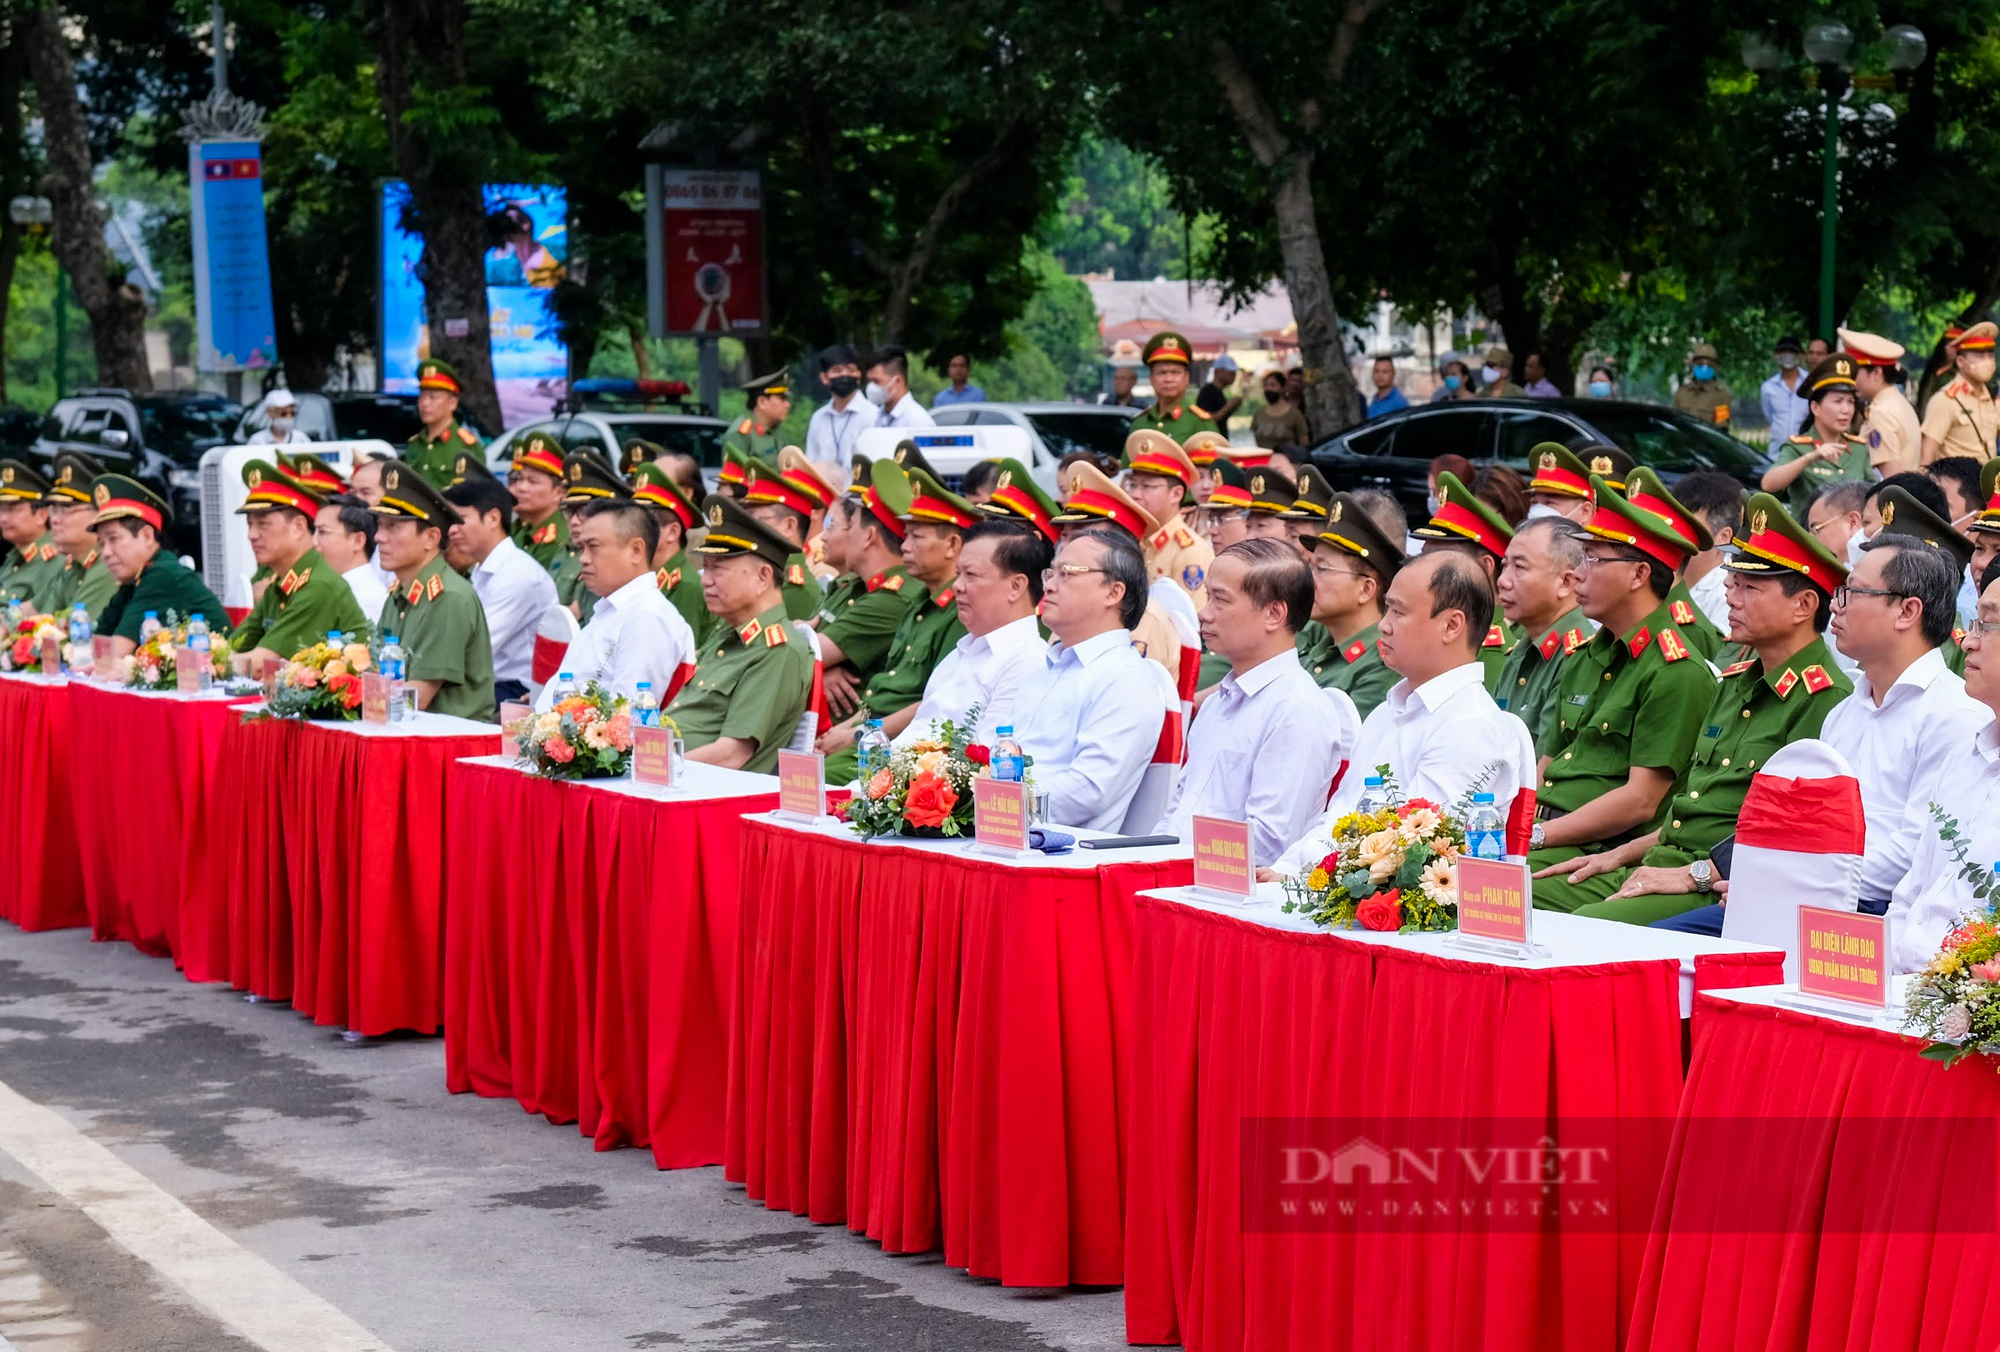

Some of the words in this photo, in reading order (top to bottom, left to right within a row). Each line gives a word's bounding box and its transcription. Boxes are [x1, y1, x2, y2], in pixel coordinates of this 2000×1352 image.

[1482, 886, 1503, 906] PHAN
[1504, 887, 1521, 909] TÂM
[1810, 930, 1822, 953] ĐẠI
[1824, 929, 1840, 956] DIỆN
[1841, 932, 1859, 956] LÃNH
[1860, 938, 1875, 962] ĐẠO
[1808, 958, 1824, 975] UBND
[1824, 960, 1840, 981] QUẬN
[1840, 964, 1850, 980] HAI
[1850, 964, 1859, 982] BÀ
[1859, 967, 1878, 986] TRƯNG
